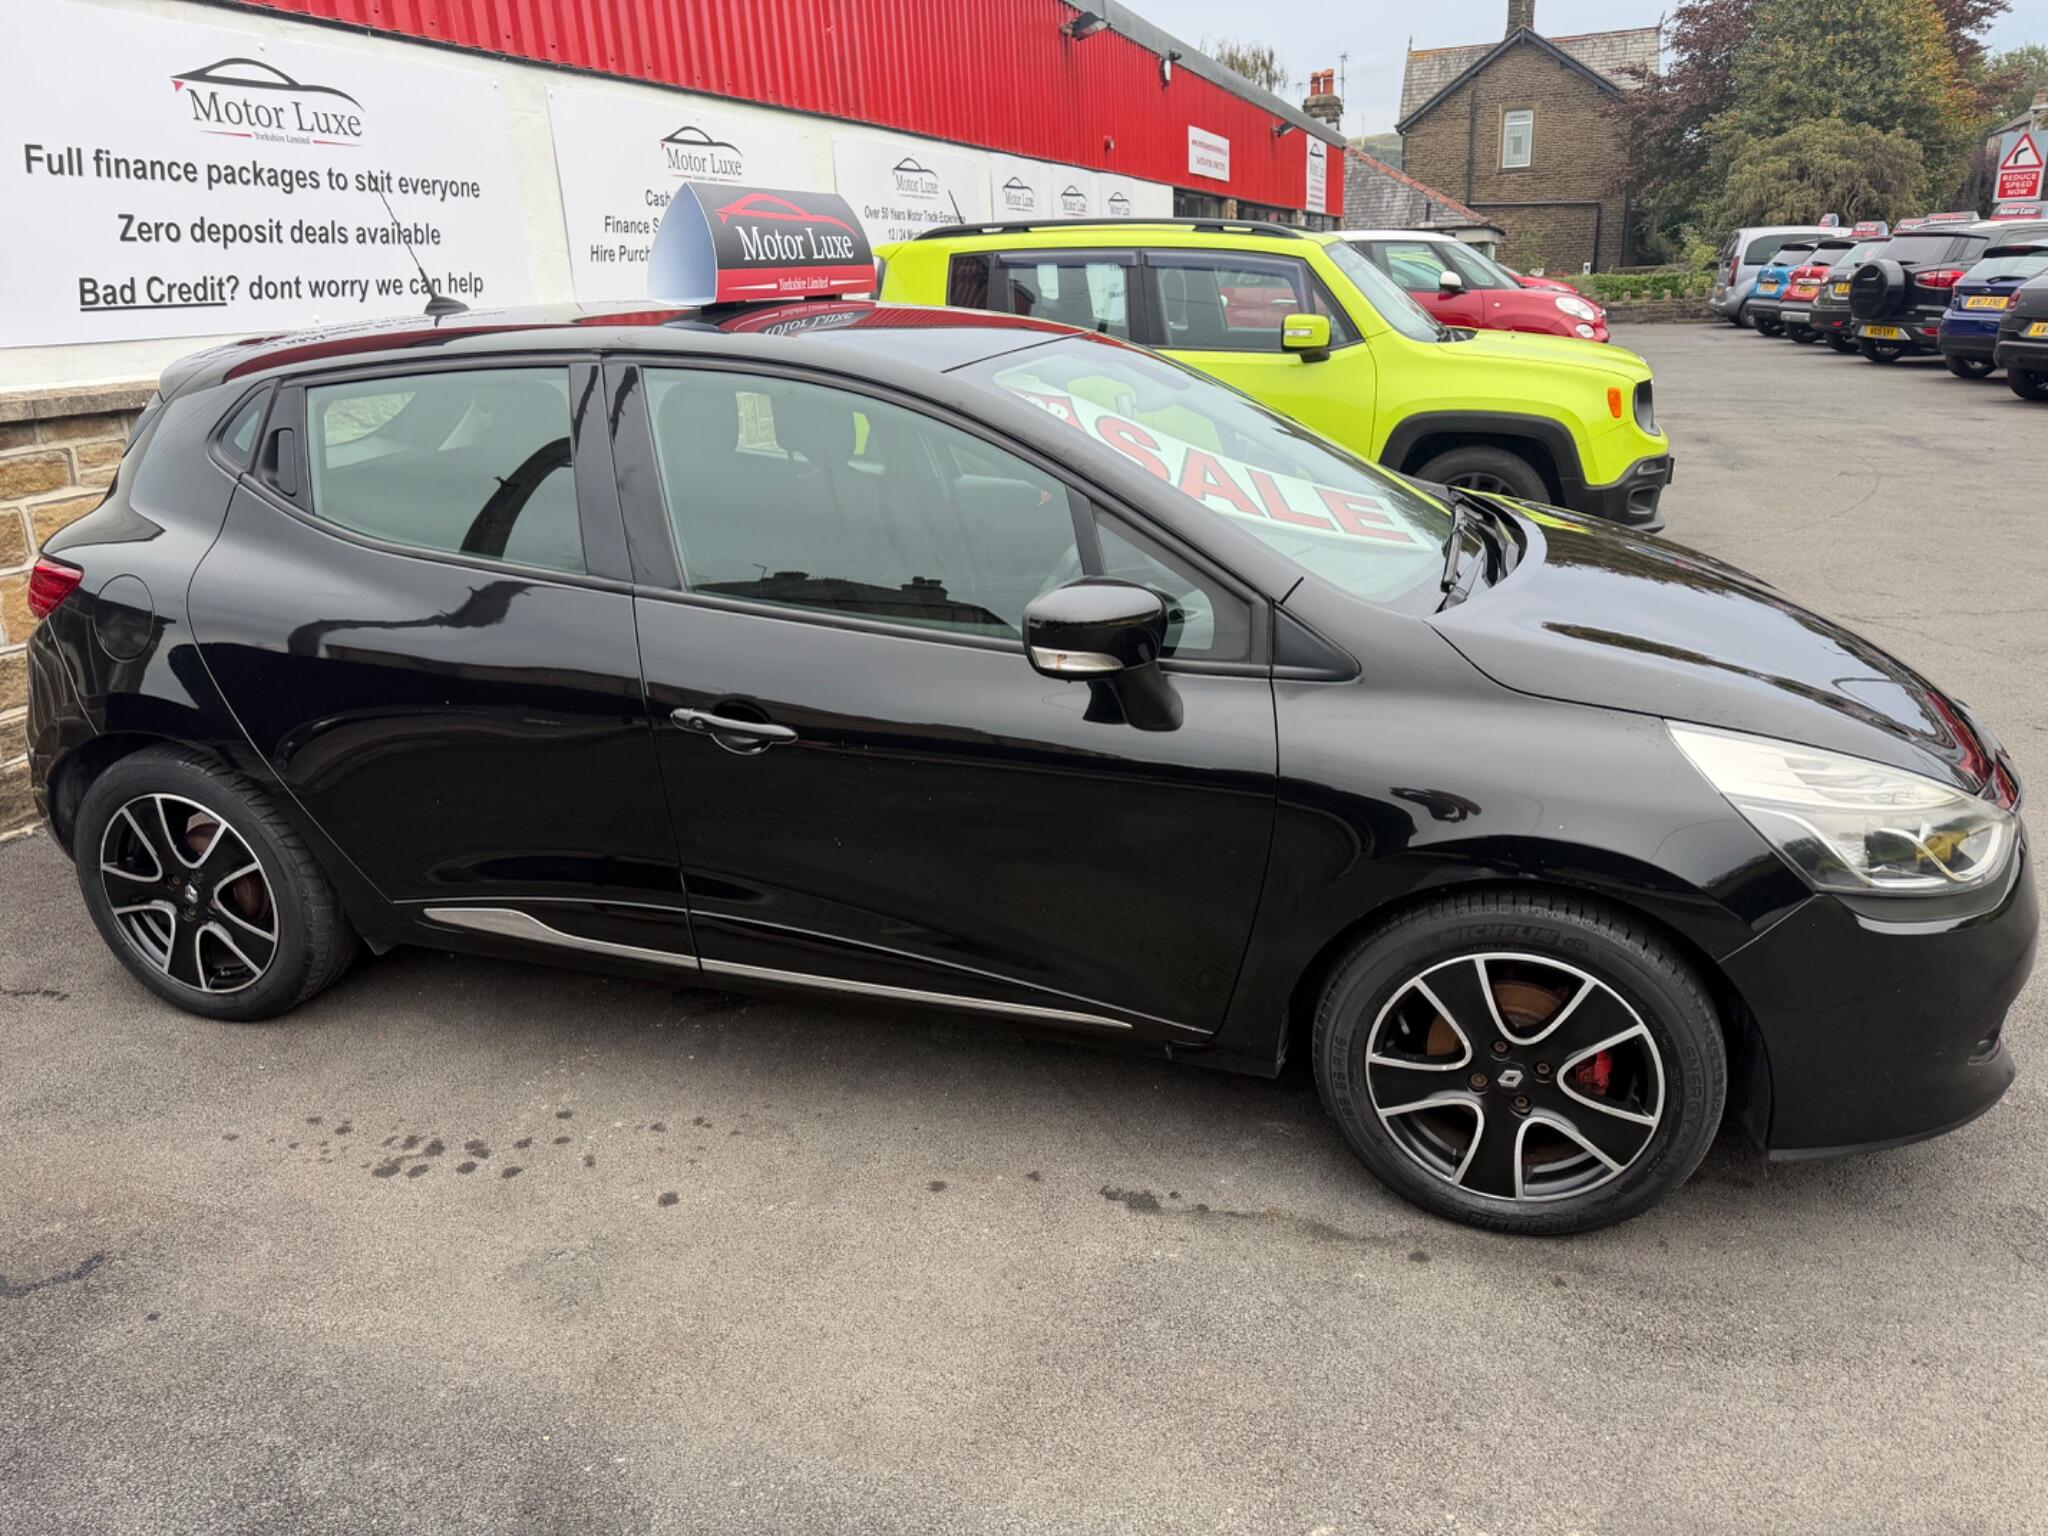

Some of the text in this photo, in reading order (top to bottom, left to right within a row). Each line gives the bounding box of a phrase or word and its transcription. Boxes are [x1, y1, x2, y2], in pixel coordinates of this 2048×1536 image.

[186, 88, 363, 137] Motor Luxe
[667, 147, 742, 175] Motor Luxe
[24, 144, 481, 201] Full finance packages to suit everyone
[2002, 173, 2037, 181] REDUCE
[2005, 181, 2033, 189] SPEED
[2007, 188, 2028, 196] NOW
[645, 189, 672, 206] Cash
[865, 205, 880, 219] Over
[118, 214, 441, 250] Zero deposit deals available
[604, 216, 650, 233] Finance
[736, 226, 854, 261] Motor Luxe
[590, 245, 615, 262] Hire
[79, 271, 484, 306] Bad Credit? dont worry we can help
[778, 276, 829, 292] Yorkshire Limited
[1096, 414, 1416, 544] SALE
